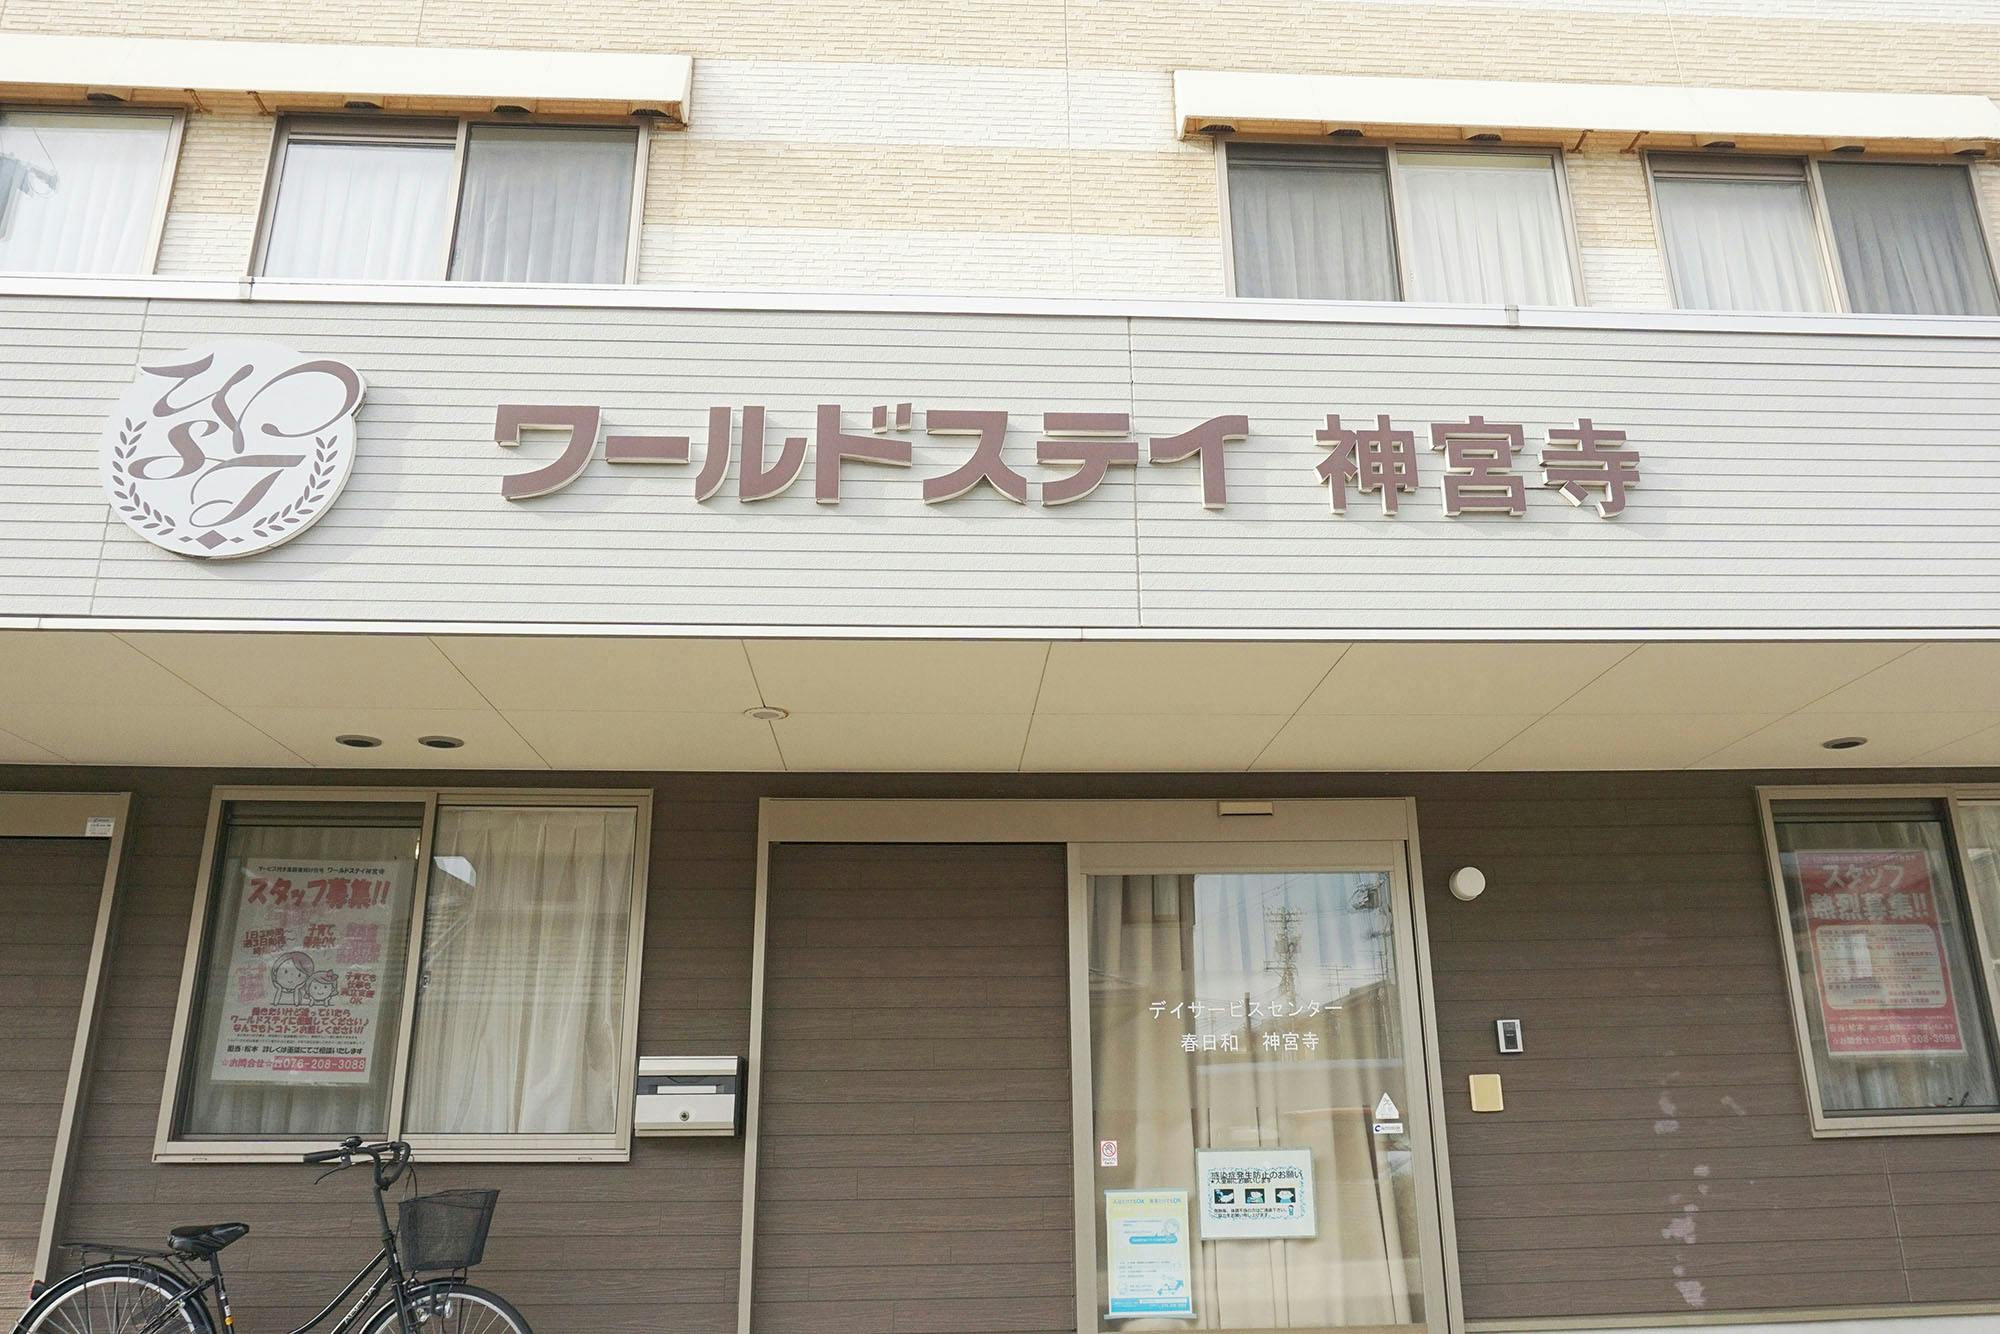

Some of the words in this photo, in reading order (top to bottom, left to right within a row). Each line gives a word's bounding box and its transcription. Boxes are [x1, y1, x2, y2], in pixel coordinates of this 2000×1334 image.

[495, 403, 1249, 510] ワールドステイ
[1313, 413, 1640, 519] 神宮寺
[1822, 863, 1905, 890] スタッフ
[1149, 1000, 1343, 1020] デイサービスセンター
[1181, 1032, 1239, 1053] 春日和
[1262, 1031, 1320, 1052] 神宮寺
[1210, 1170, 1303, 1180] 感染症発生防止のお願い
